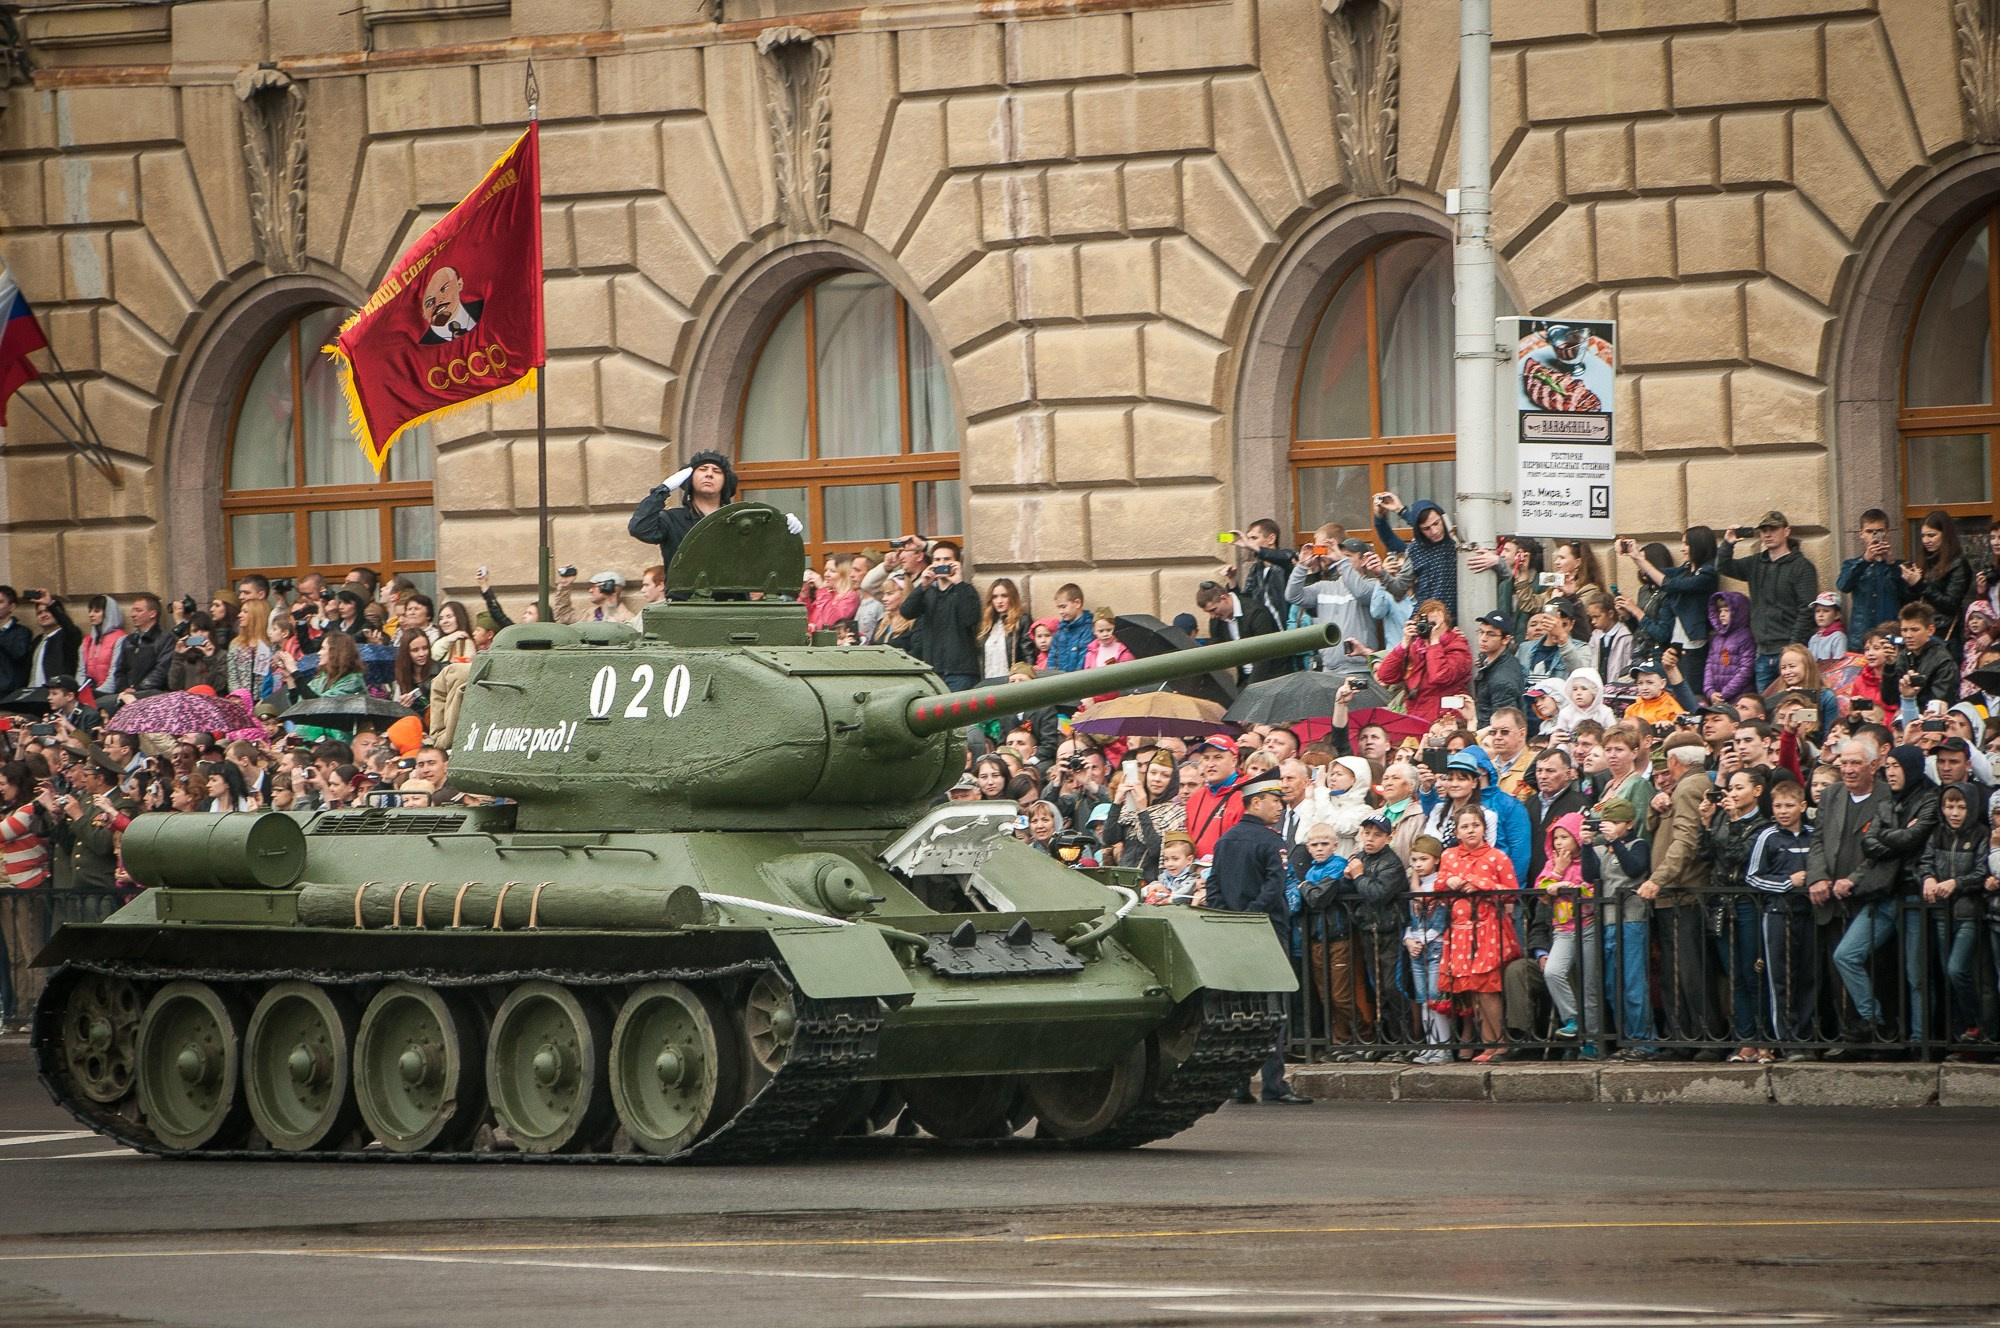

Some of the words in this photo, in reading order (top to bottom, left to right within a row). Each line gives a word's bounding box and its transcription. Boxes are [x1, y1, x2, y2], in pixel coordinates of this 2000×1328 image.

[363, 276, 402, 317] НАШУ
[427, 343, 508, 390] СССР
[1551, 452, 1584, 461] РЕСТОРАН
[1522, 489, 1535, 499] ул.
[1538, 488, 1563, 499] Мира,
[1565, 488, 1571, 497] 5
[589, 664, 691, 718] 020
[463, 721, 480, 752] За
[482, 719, 578, 760] Сталинград!
